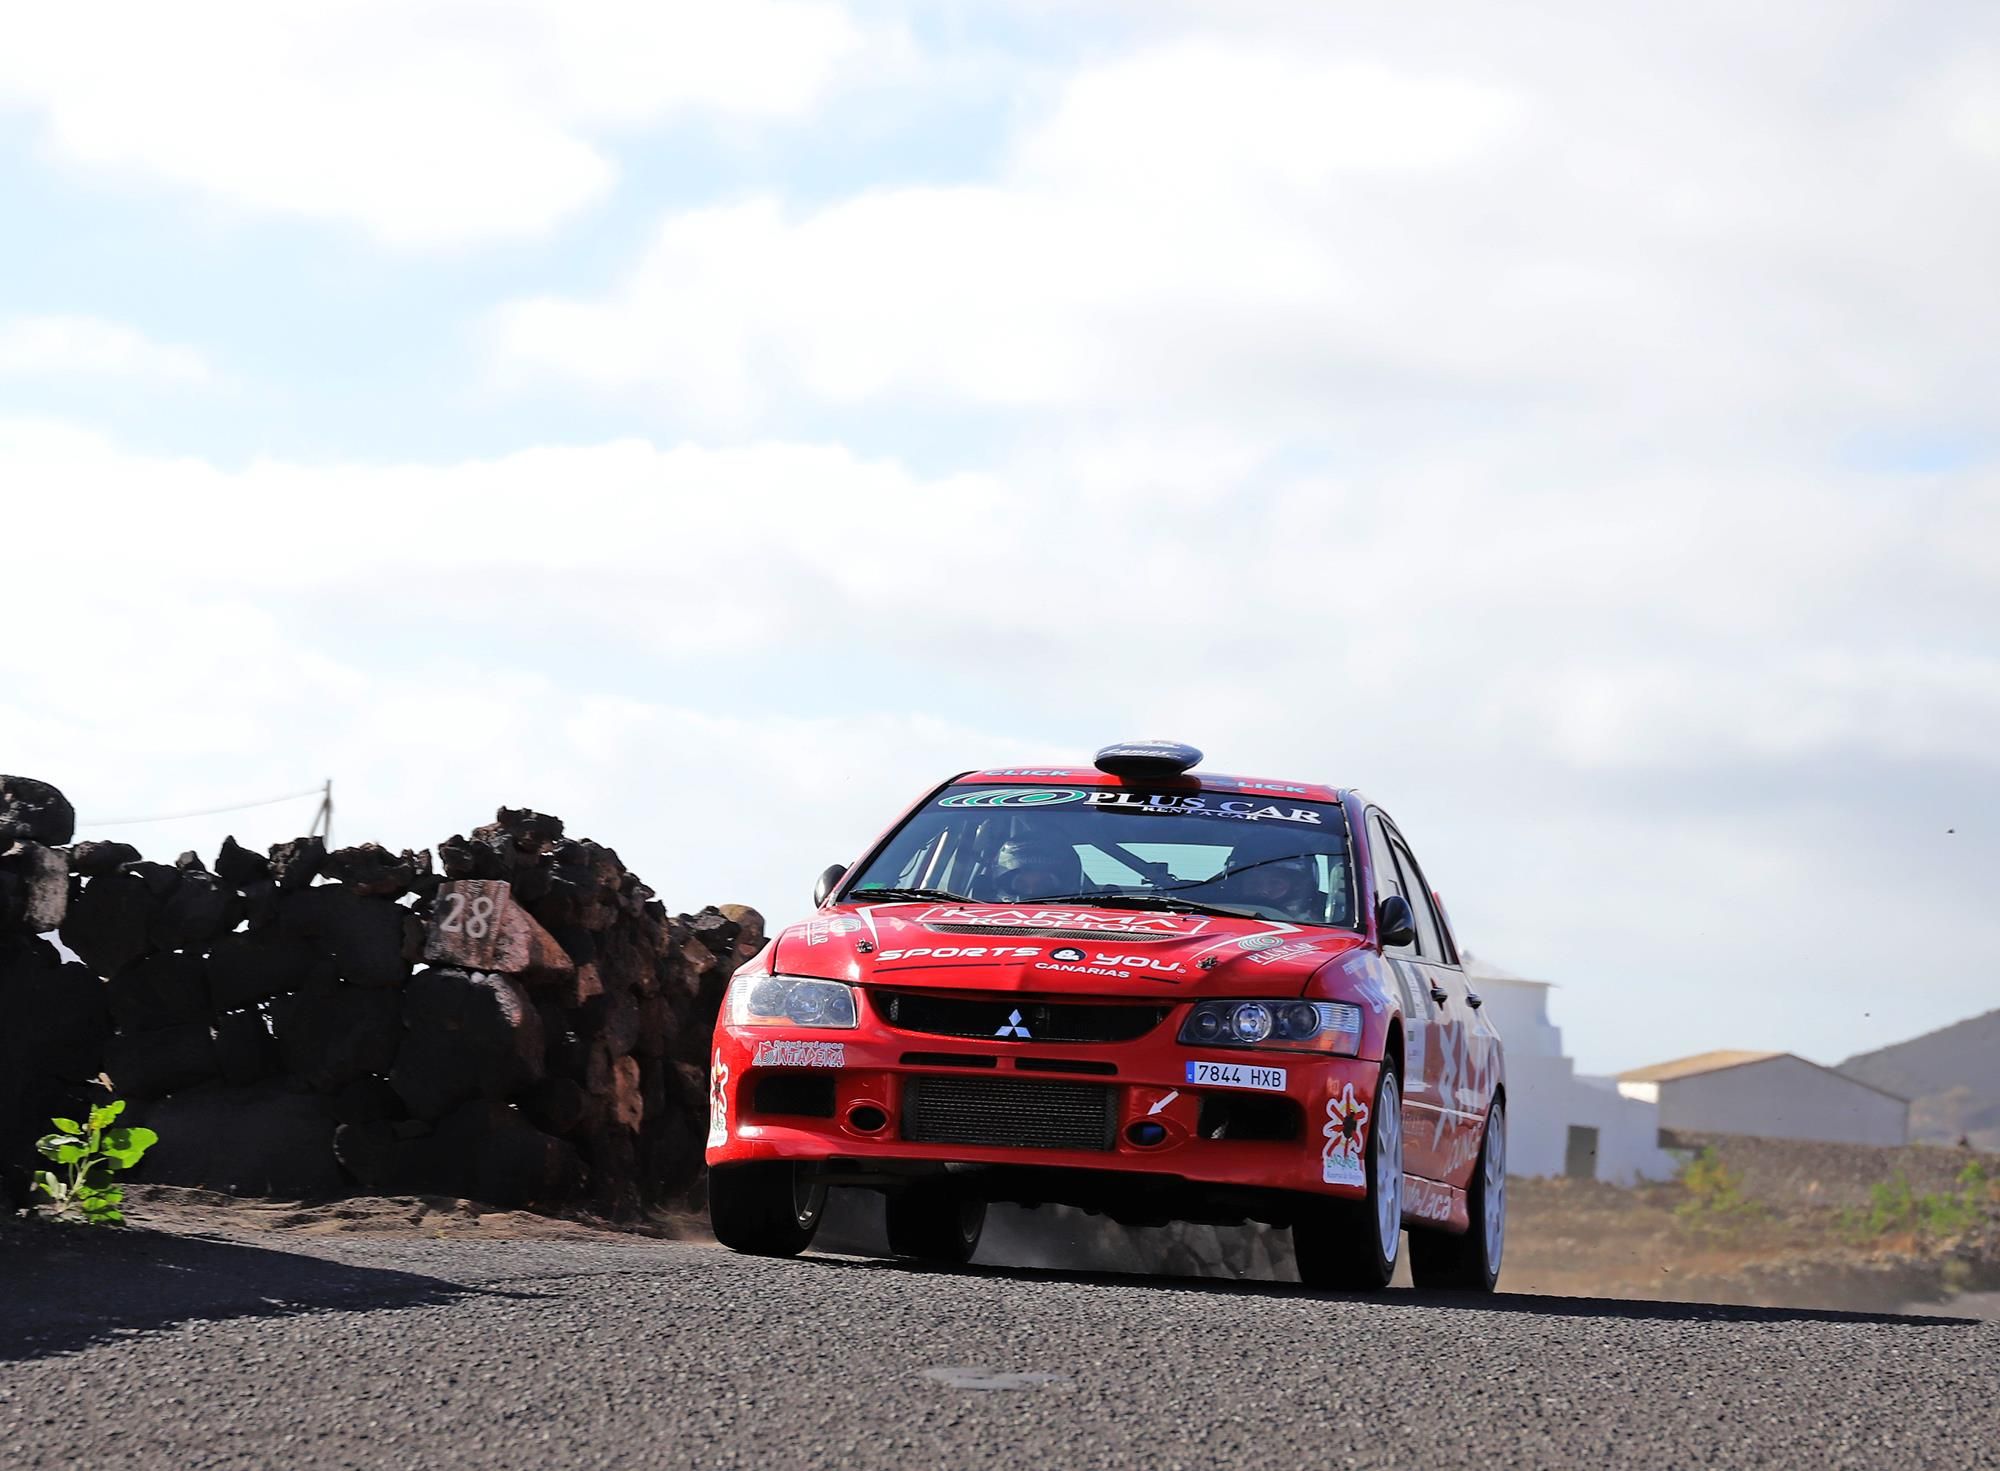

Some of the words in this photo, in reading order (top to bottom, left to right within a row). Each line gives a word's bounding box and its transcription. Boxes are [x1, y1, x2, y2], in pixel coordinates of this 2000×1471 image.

[984, 769, 1072, 777] CLICK
[1085, 791, 1206, 809] PLUS
[1220, 801, 1322, 825] CAR
[1142, 806, 1198, 814] RENT
[1217, 813, 1259, 821] CAR
[440, 892, 494, 939] 28
[941, 909, 1179, 929] KARMA
[968, 917, 1151, 932] ROOFTOP
[875, 947, 1043, 962] SPORTS
[1052, 949, 1081, 962] &
[1034, 962, 1131, 978] CANARIAS
[1199, 1065, 1241, 1083] 7844
[1251, 1069, 1282, 1088] HXB
